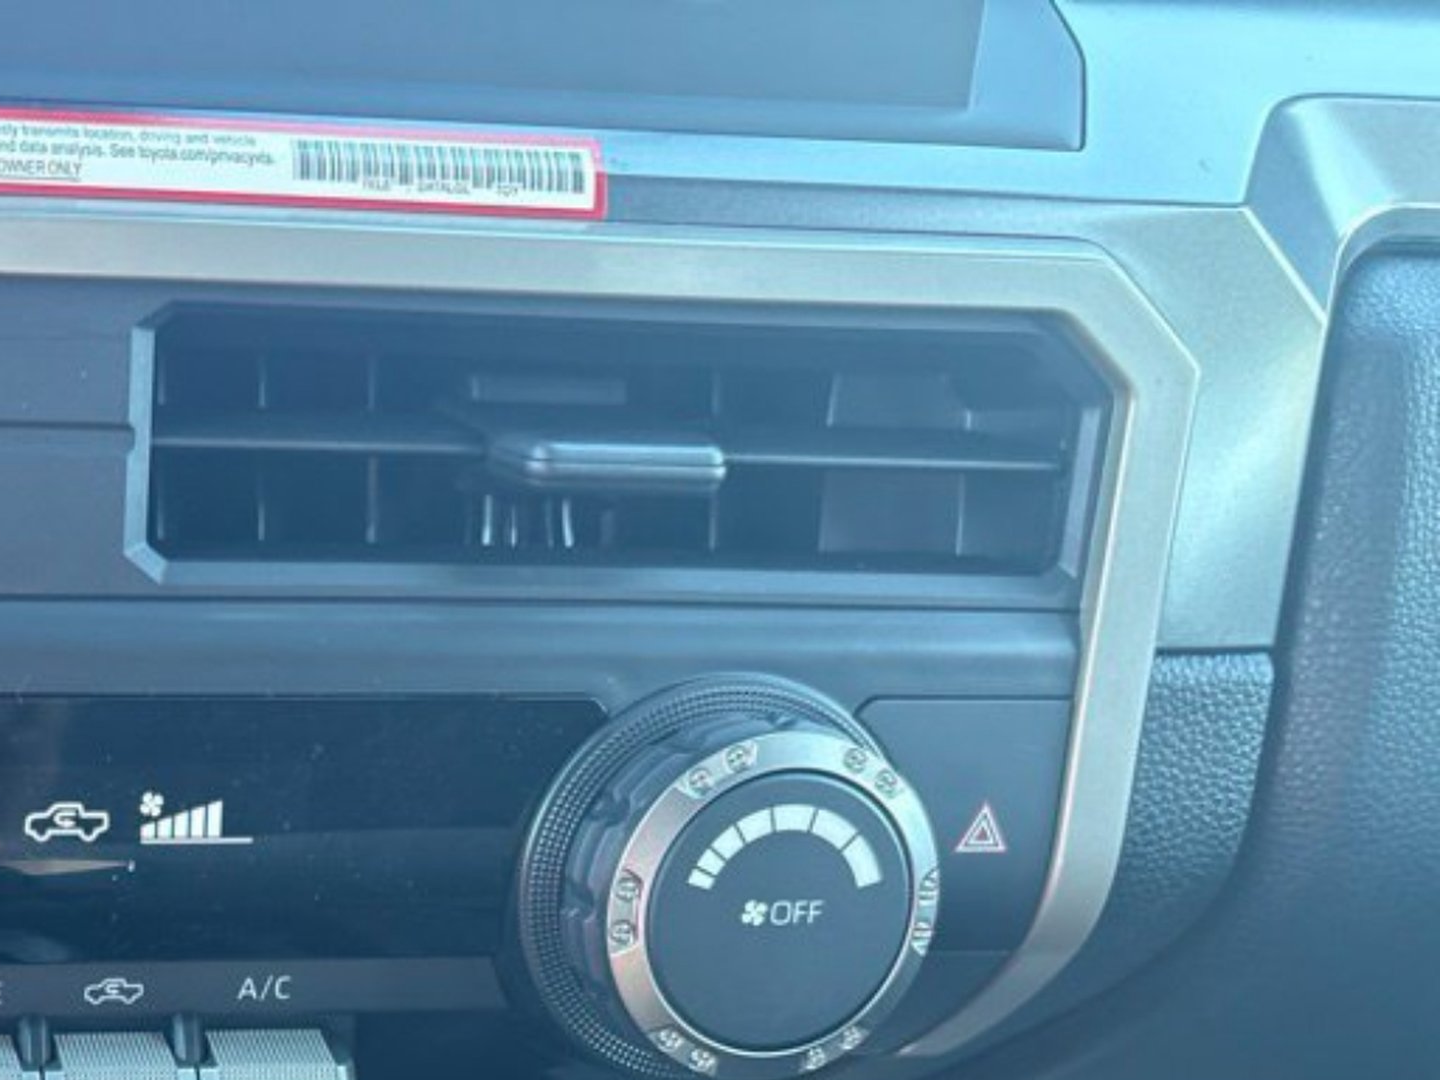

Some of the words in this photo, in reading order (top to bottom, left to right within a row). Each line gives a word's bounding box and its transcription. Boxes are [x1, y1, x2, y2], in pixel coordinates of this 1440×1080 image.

[18, 140, 49, 154] data
[109, 143, 137, 159] See
[46, 160, 82, 178] ONLY
[769, 900, 824, 927] OFF
[237, 976, 291, 1001] A/C
